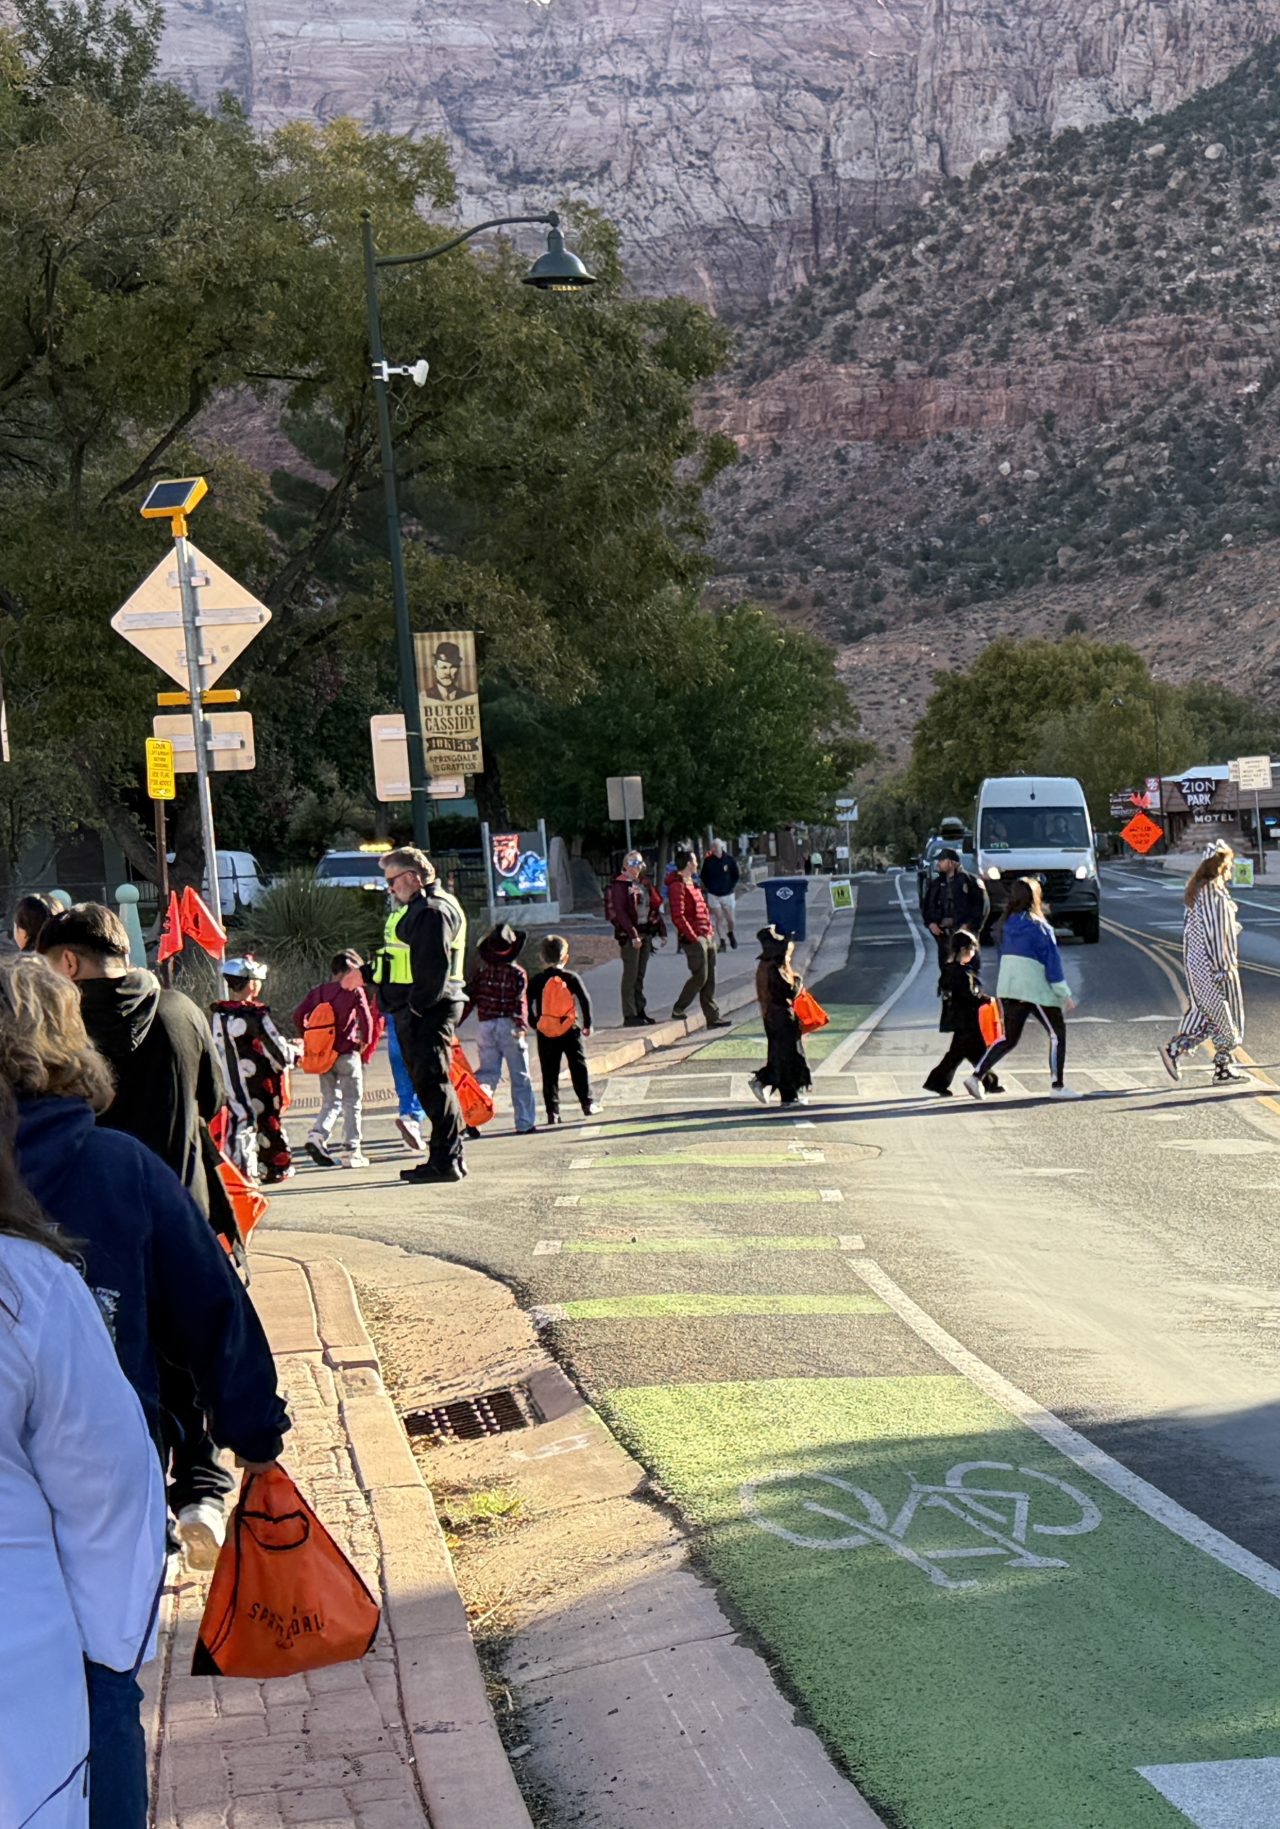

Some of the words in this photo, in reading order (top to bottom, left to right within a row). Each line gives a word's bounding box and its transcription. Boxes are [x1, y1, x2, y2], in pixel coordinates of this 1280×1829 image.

[424, 705, 475, 717] BUTCH
[425, 716, 476, 731] CASSIDY
[1181, 781, 1216, 793] ZION
[1187, 793, 1211, 806] PARK
[1194, 813, 1235, 823] MOTEL
